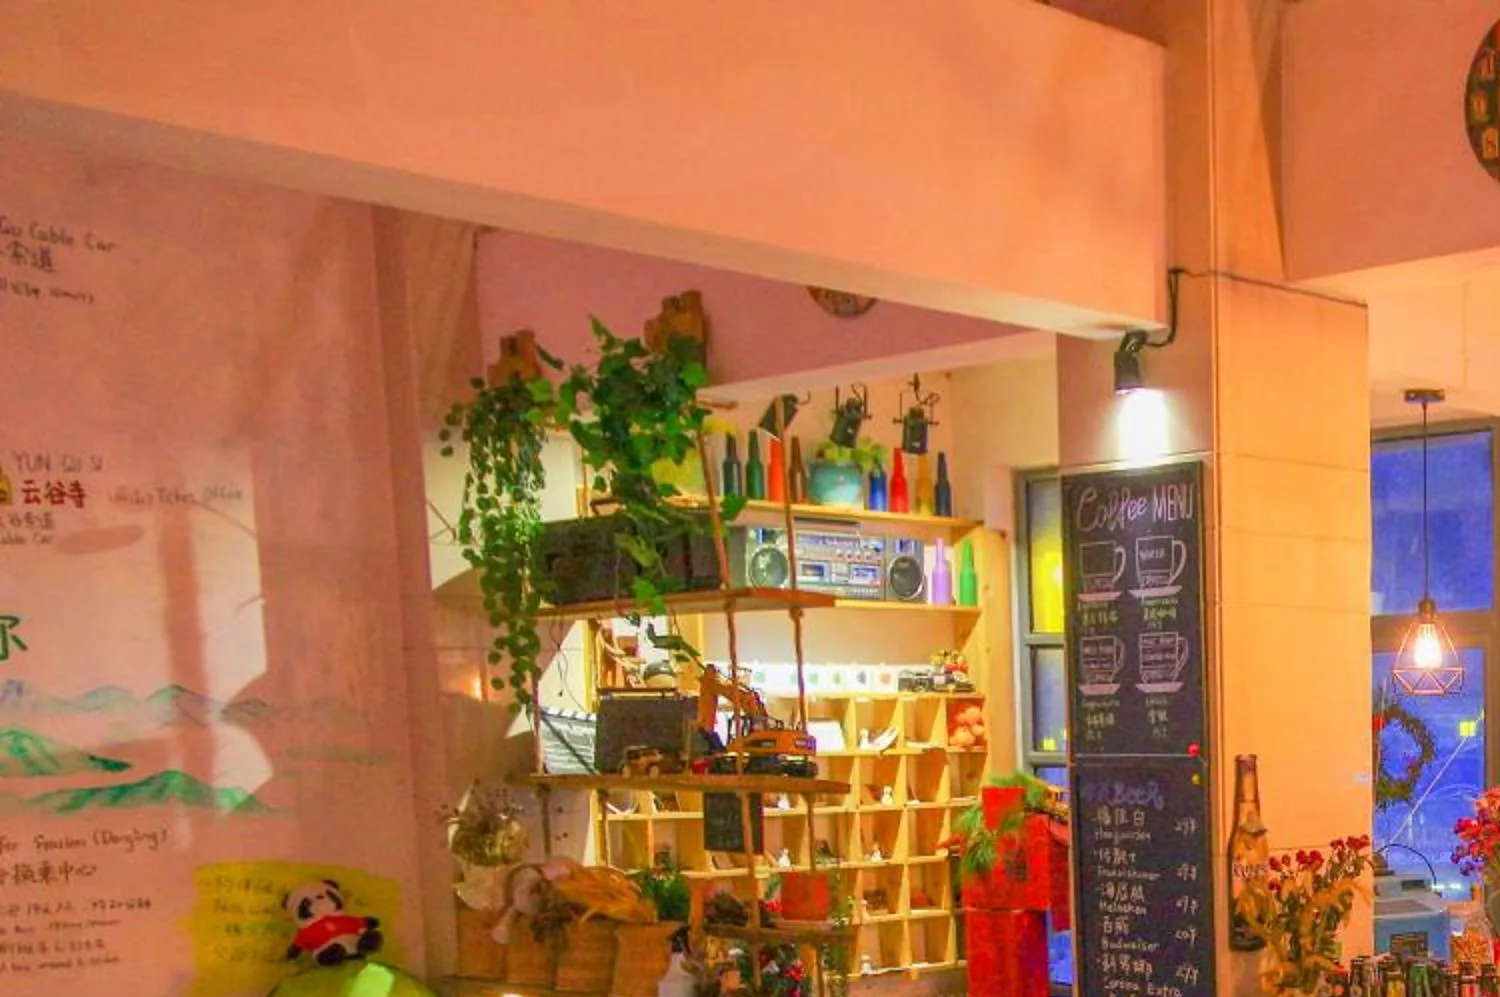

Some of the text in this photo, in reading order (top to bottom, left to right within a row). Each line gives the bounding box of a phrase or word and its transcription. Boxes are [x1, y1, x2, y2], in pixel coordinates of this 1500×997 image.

[21, 479, 87, 509] 云谷寺
[1076, 483, 1193, 533] Coffee MENU
